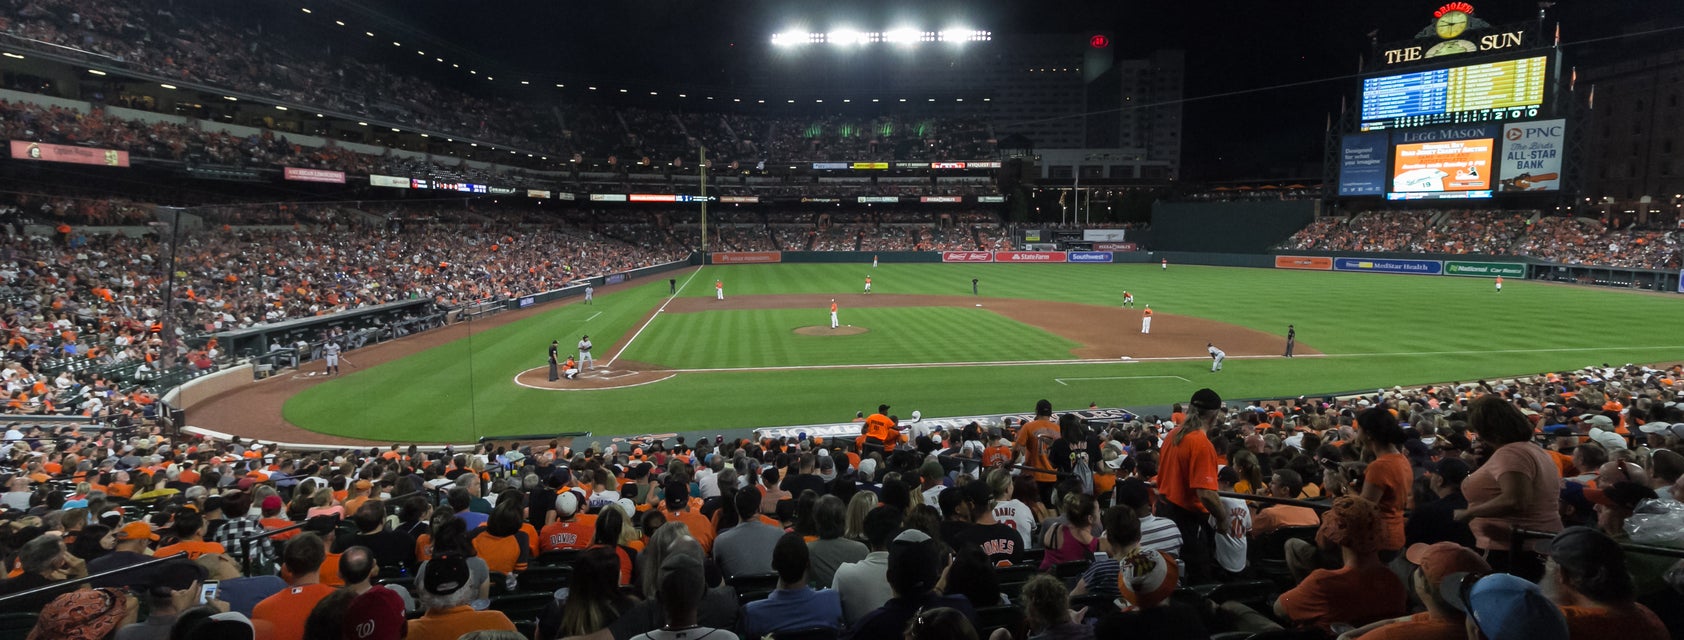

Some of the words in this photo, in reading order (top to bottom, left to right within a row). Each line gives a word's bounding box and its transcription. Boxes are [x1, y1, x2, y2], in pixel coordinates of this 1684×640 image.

[1434, 2, 1474, 18] ORIOLES
[1385, 46, 1422, 64] THE
[1480, 31, 1523, 51] SUN
[1495, 112, 1503, 120] 2
[1512, 110, 1521, 118] 0
[1528, 109, 1537, 117] 0
[1440, 128, 1486, 139] MASON
[1526, 126, 1562, 138] PNC
[1507, 150, 1557, 160] ALL-STAR
[1517, 160, 1544, 170] BANK
[1374, 262, 1402, 270] MedStar
[1458, 265, 1488, 273] National
[994, 507, 1016, 516] DAVIS
[550, 533, 577, 545] DAVIS
[980, 539, 1014, 555] ONES
[356, 619, 375, 638] W
